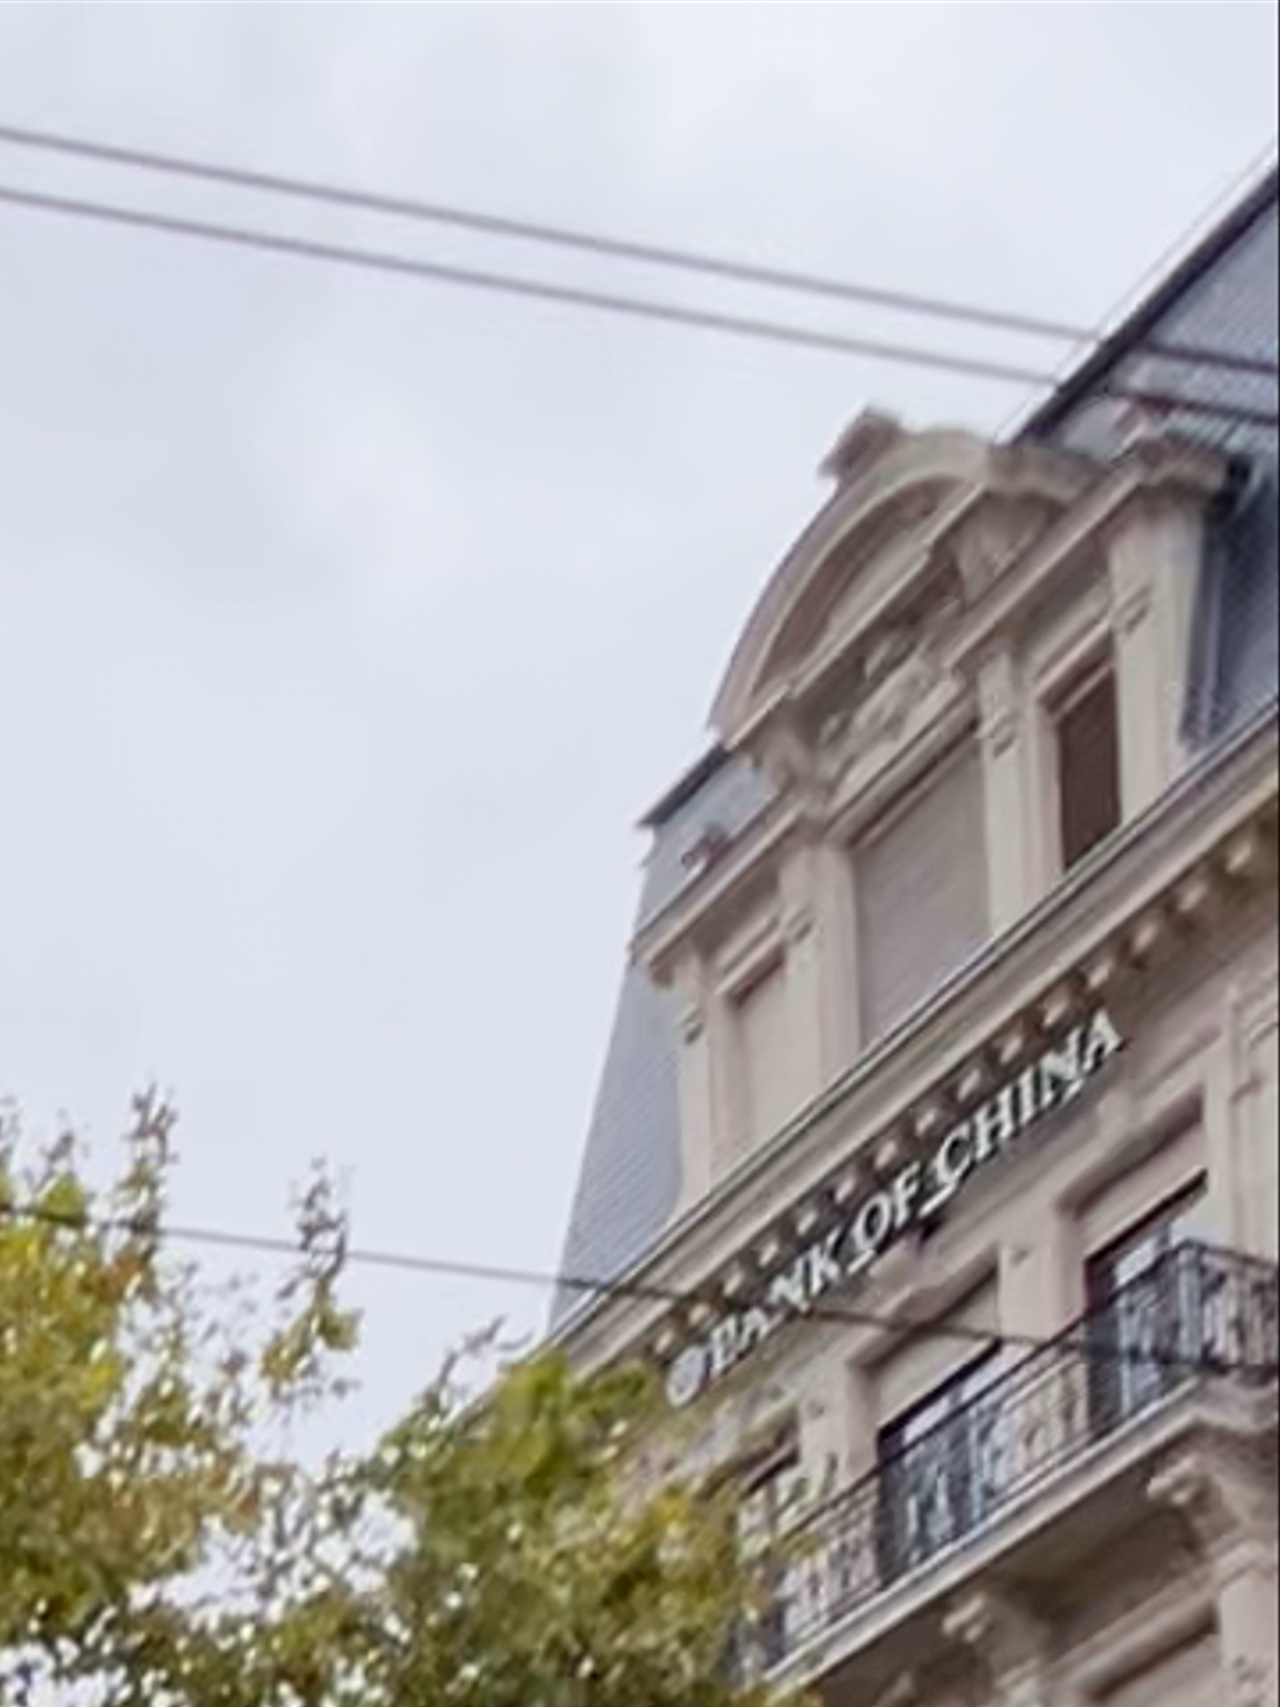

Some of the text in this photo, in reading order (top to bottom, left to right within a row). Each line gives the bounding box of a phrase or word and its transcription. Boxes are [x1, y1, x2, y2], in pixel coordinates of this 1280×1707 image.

[706, 1008, 1124, 1380] BANK OF CHINA
